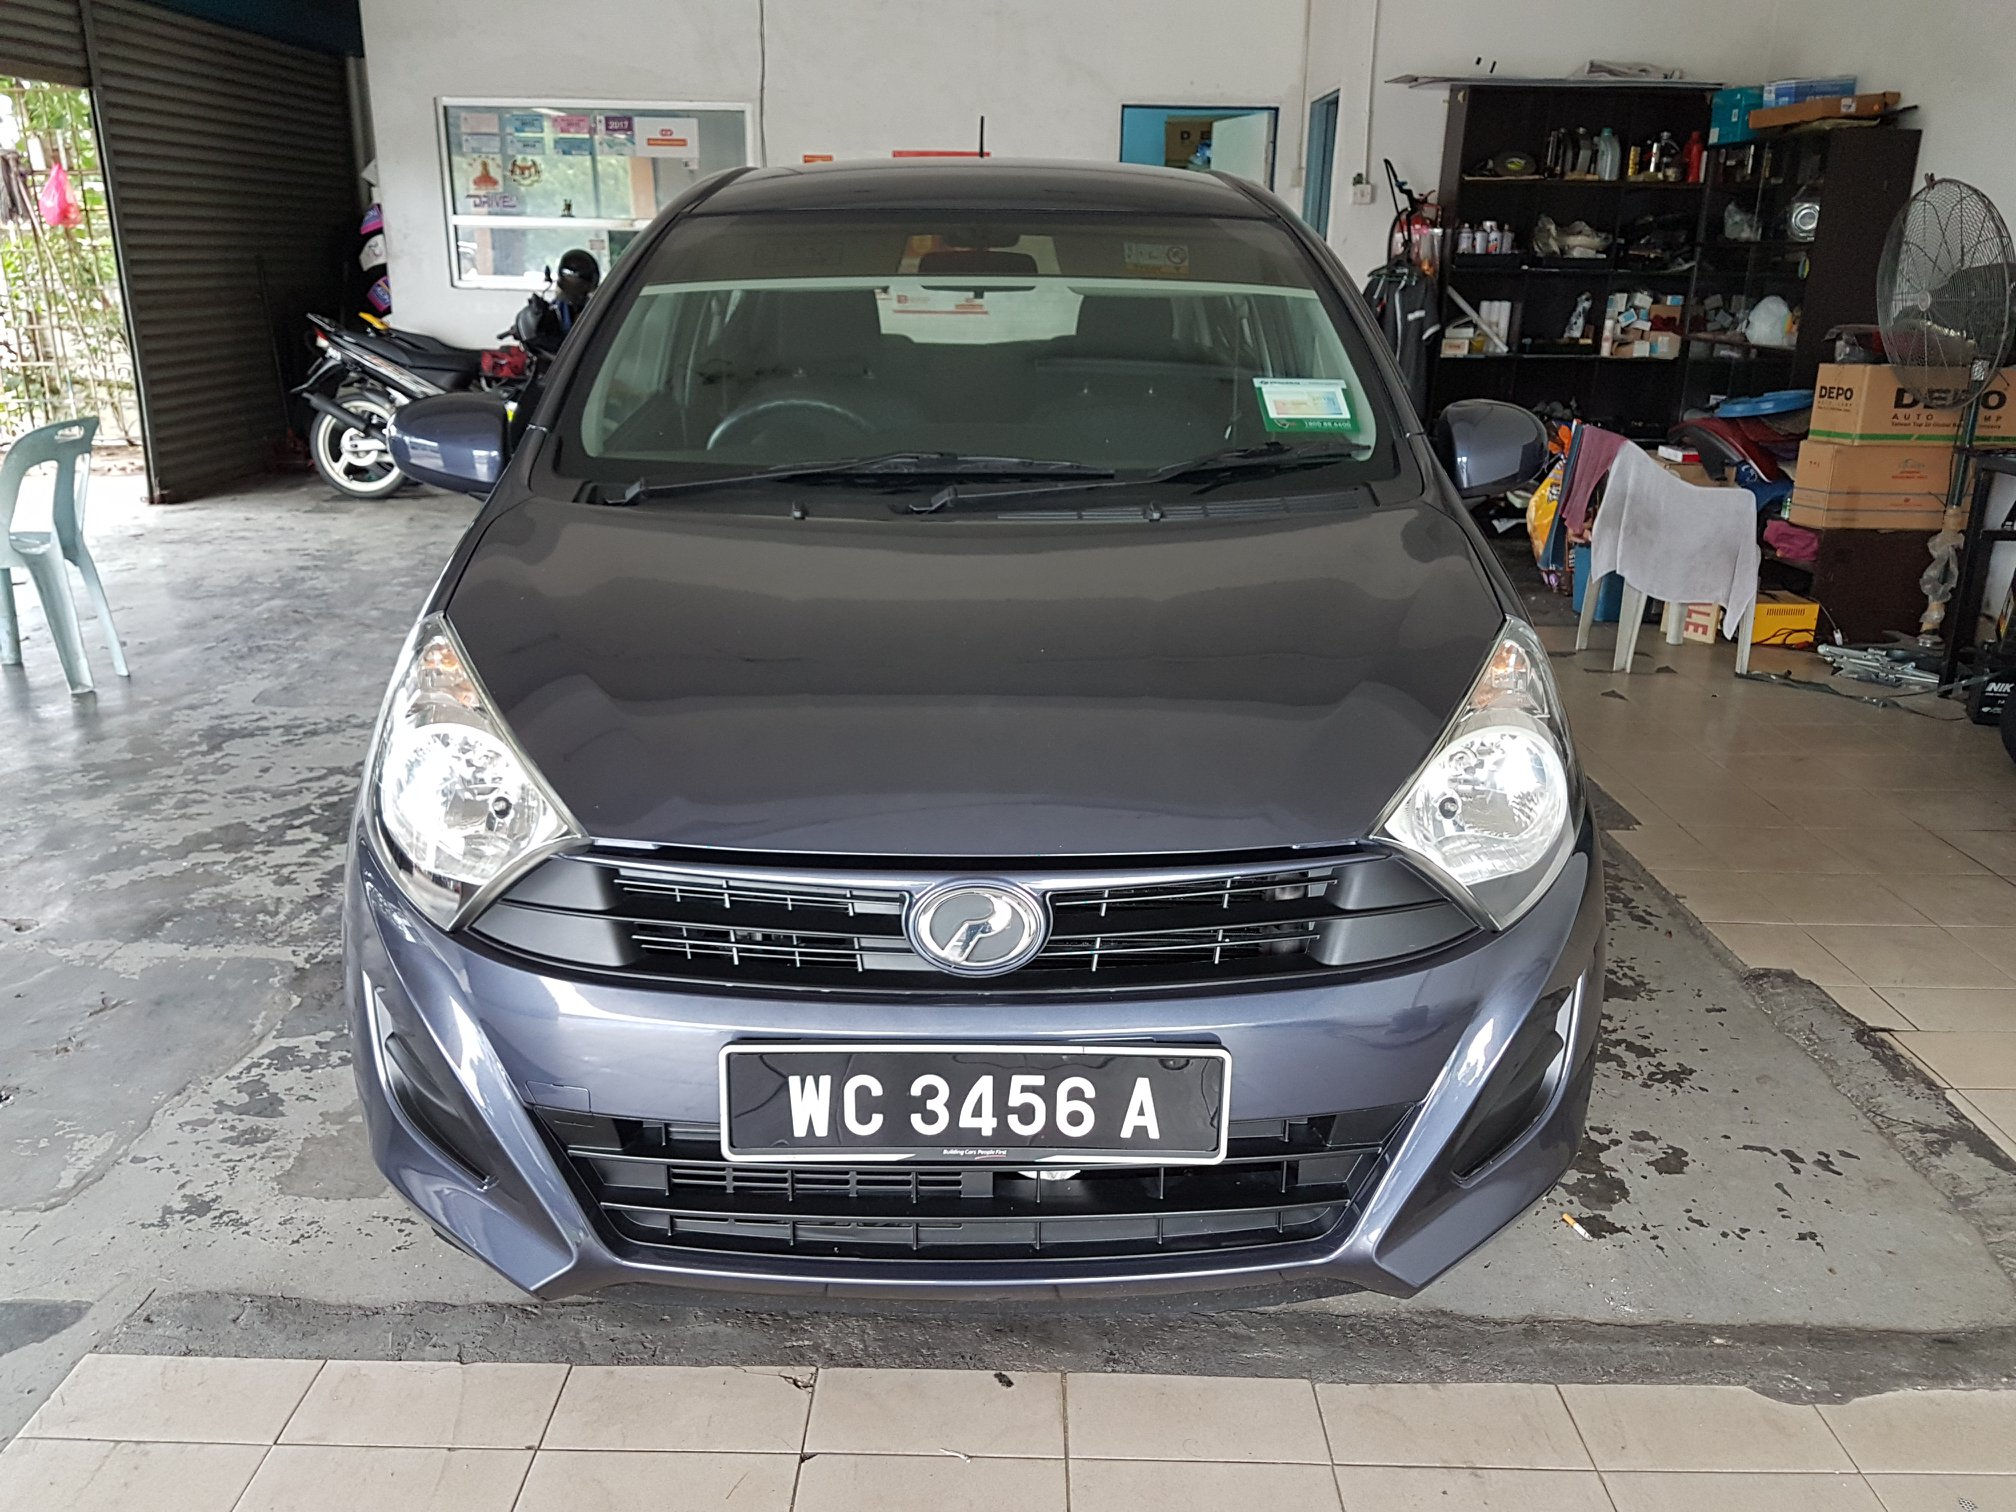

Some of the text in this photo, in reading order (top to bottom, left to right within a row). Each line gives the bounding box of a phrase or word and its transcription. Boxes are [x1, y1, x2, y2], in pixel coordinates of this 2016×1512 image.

[1818, 385, 1854, 401] DEPO
[1891, 413, 1934, 421] AUTO
[788, 1074, 1161, 1140] WC 3456 A
